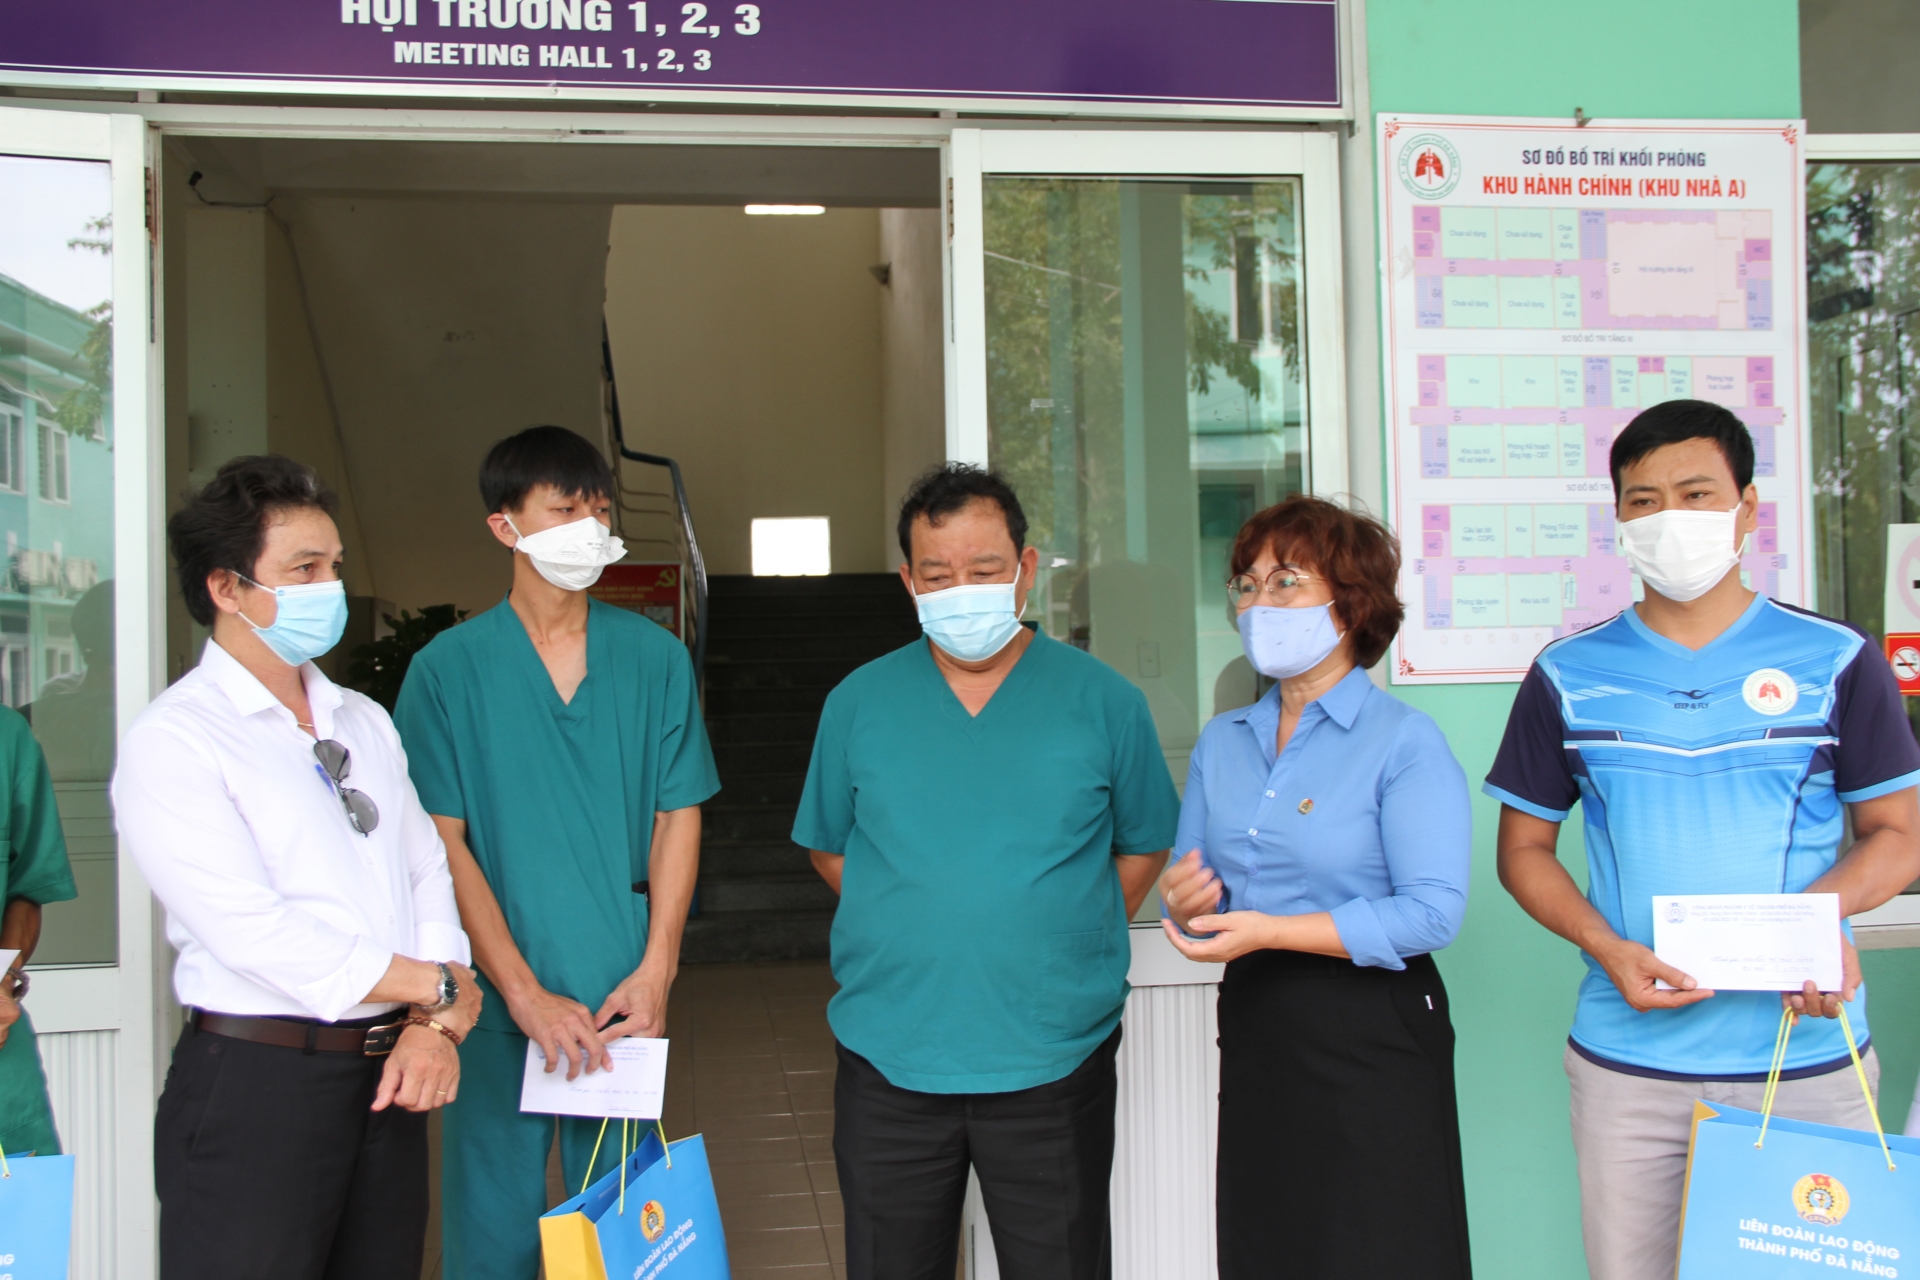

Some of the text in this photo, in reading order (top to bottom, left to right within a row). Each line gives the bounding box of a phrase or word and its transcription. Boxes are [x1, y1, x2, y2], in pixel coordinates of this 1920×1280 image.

[627, 1, 667, 37] 1,
[680, 2, 721, 38] 2,
[734, 3, 761, 35] 3
[394, 41, 712, 73] MEETING HALL 1, 2, 3
[1522, 149, 1541, 165] SƠ
[1569, 145, 1588, 165] BỐ
[1593, 147, 1615, 166] TRÍ
[1619, 146, 1651, 166] KHỐI
[1483, 172, 1746, 199] KHU HÀNH CHÍNH (KHU NHÀ A)
[644, 1246, 662, 1268] ĐOÀN
[660, 1235, 674, 1252] LAO
[1739, 1217, 1900, 1260] LIÊN ĐOÀN LAO ĐỘNG
[1738, 1236, 1898, 1279] THÀNH PHỐ ĐÀ NẴNG
